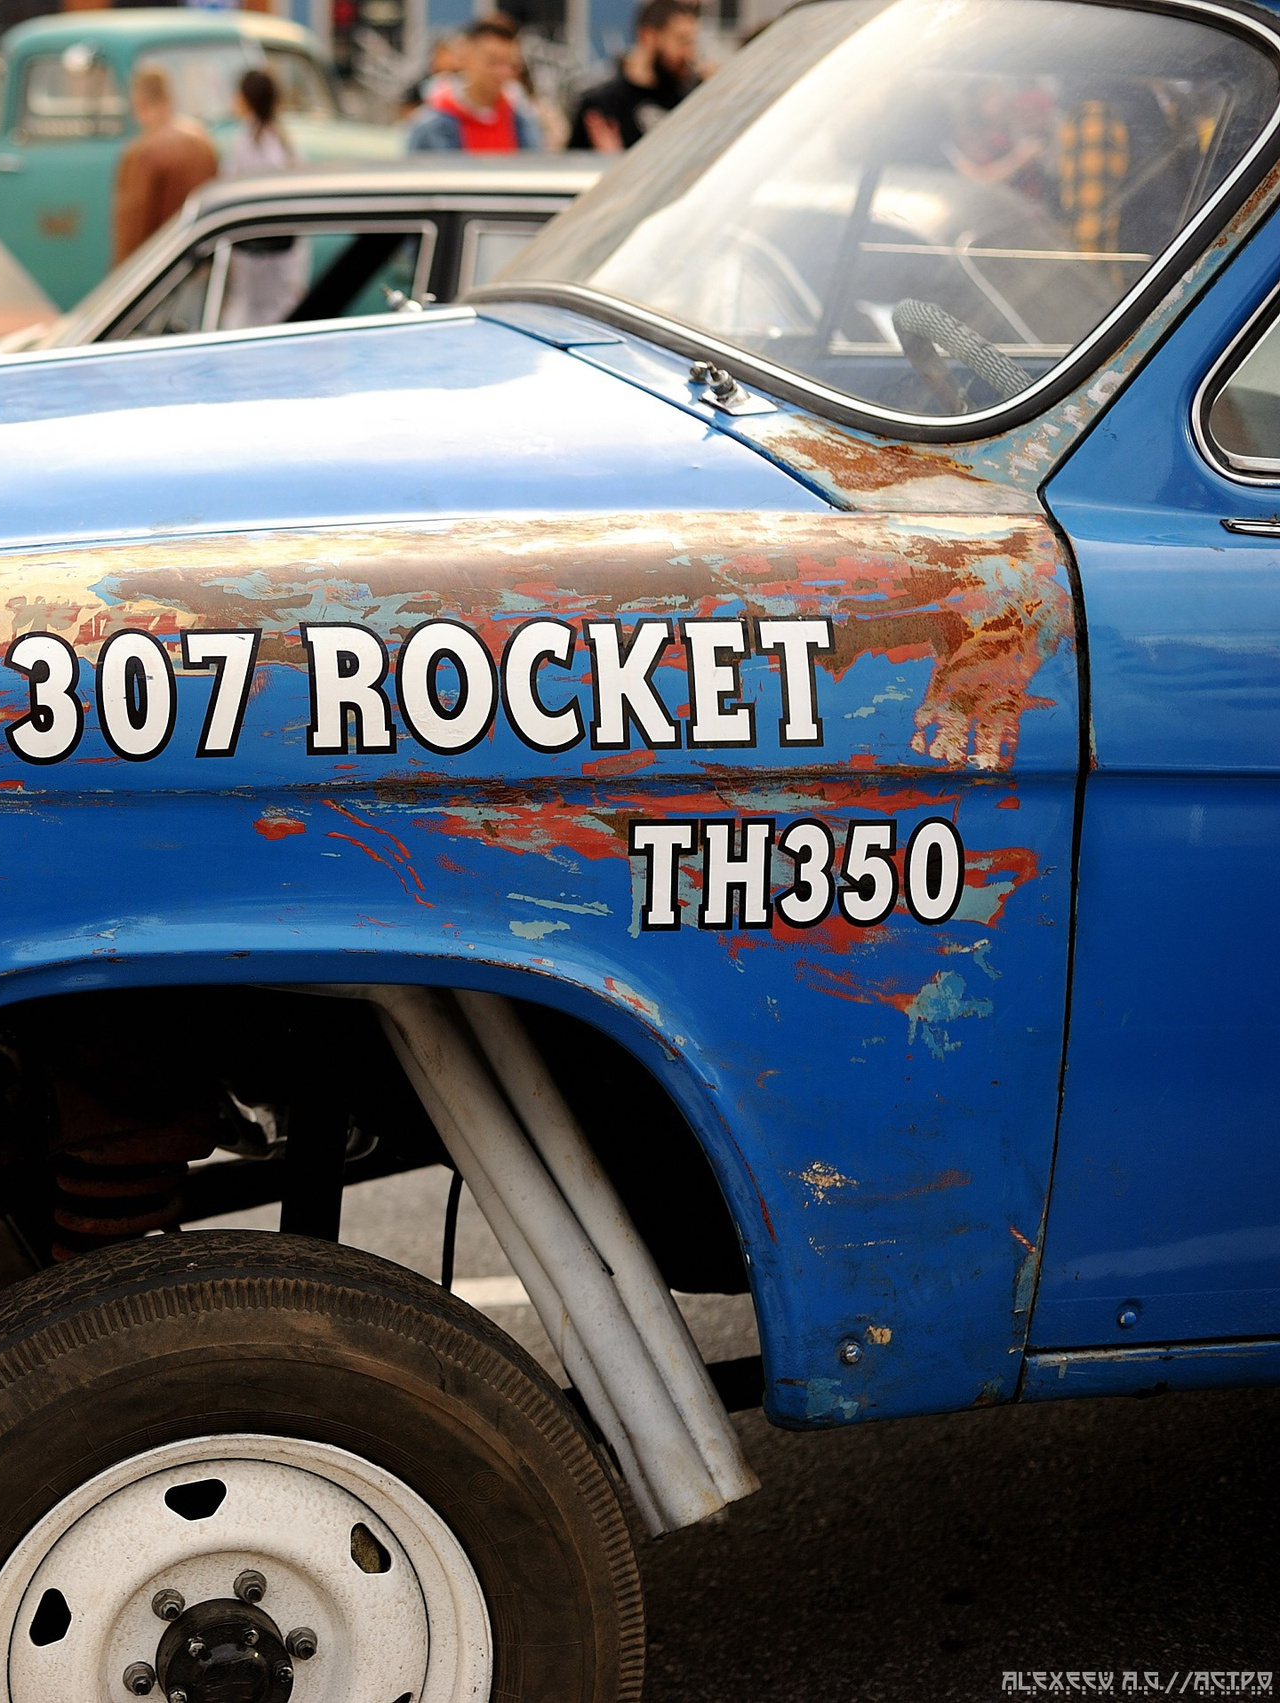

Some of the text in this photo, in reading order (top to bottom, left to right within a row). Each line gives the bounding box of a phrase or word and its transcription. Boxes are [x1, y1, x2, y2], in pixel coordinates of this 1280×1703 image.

[3, 628, 262, 766] 307
[299, 616, 834, 755] ROCKET
[628, 817, 965, 932] TH350
